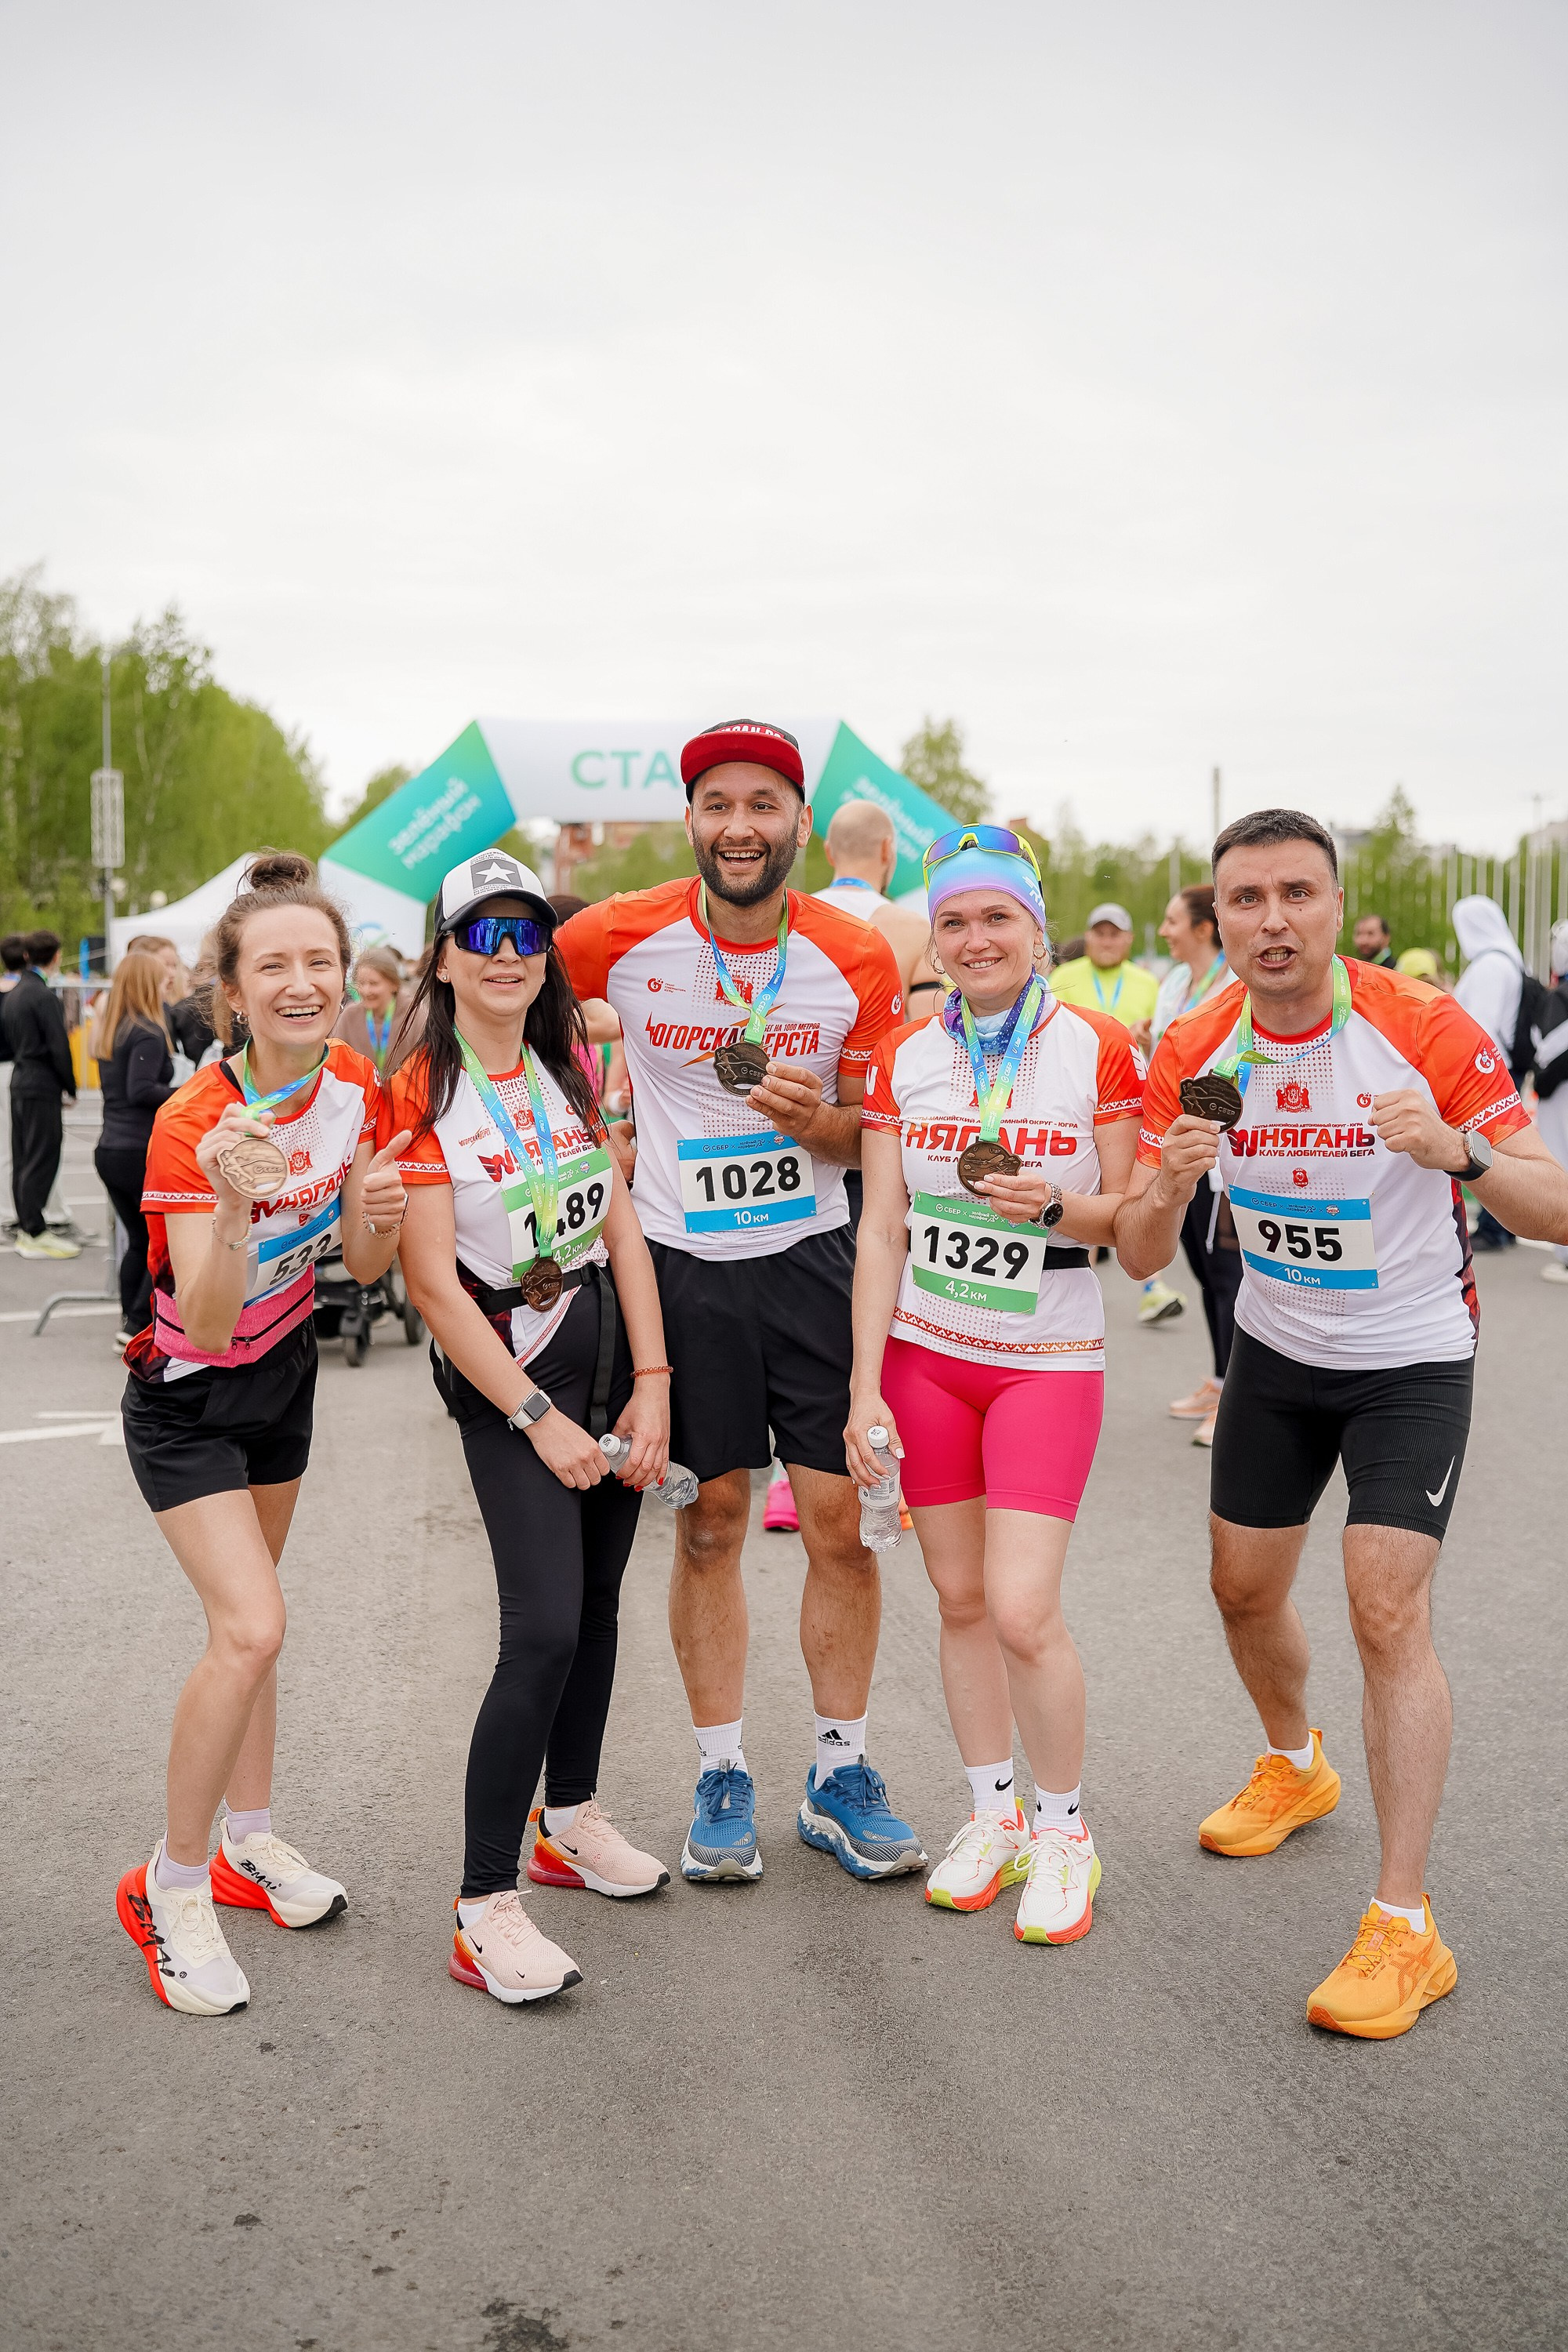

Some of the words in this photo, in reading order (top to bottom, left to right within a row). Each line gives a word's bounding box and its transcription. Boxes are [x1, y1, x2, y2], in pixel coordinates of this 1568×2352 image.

[571, 750, 679, 789] СТА
[784, 1023, 797, 1032] 1000
[762, 1030, 819, 1058] ЕРСТА
[1004, 1061, 1013, 1076] СБЕР
[1218, 1107, 1236, 1116] СБЕР
[1259, 1127, 1376, 1149] НЯГАНЬ
[515, 1144, 528, 1164] СБЕР
[1350, 1149, 1375, 1157] БЕГА
[696, 1156, 800, 1202] 1028
[734, 1211, 752, 1225] 10
[1258, 1219, 1343, 1262] 955
[269, 1233, 332, 1286] 533
[924, 1225, 1029, 1279] 1329
[1284, 1267, 1302, 1282] 10
[946, 1280, 970, 1298] 4,2
[818, 1735, 851, 1746] adidas
